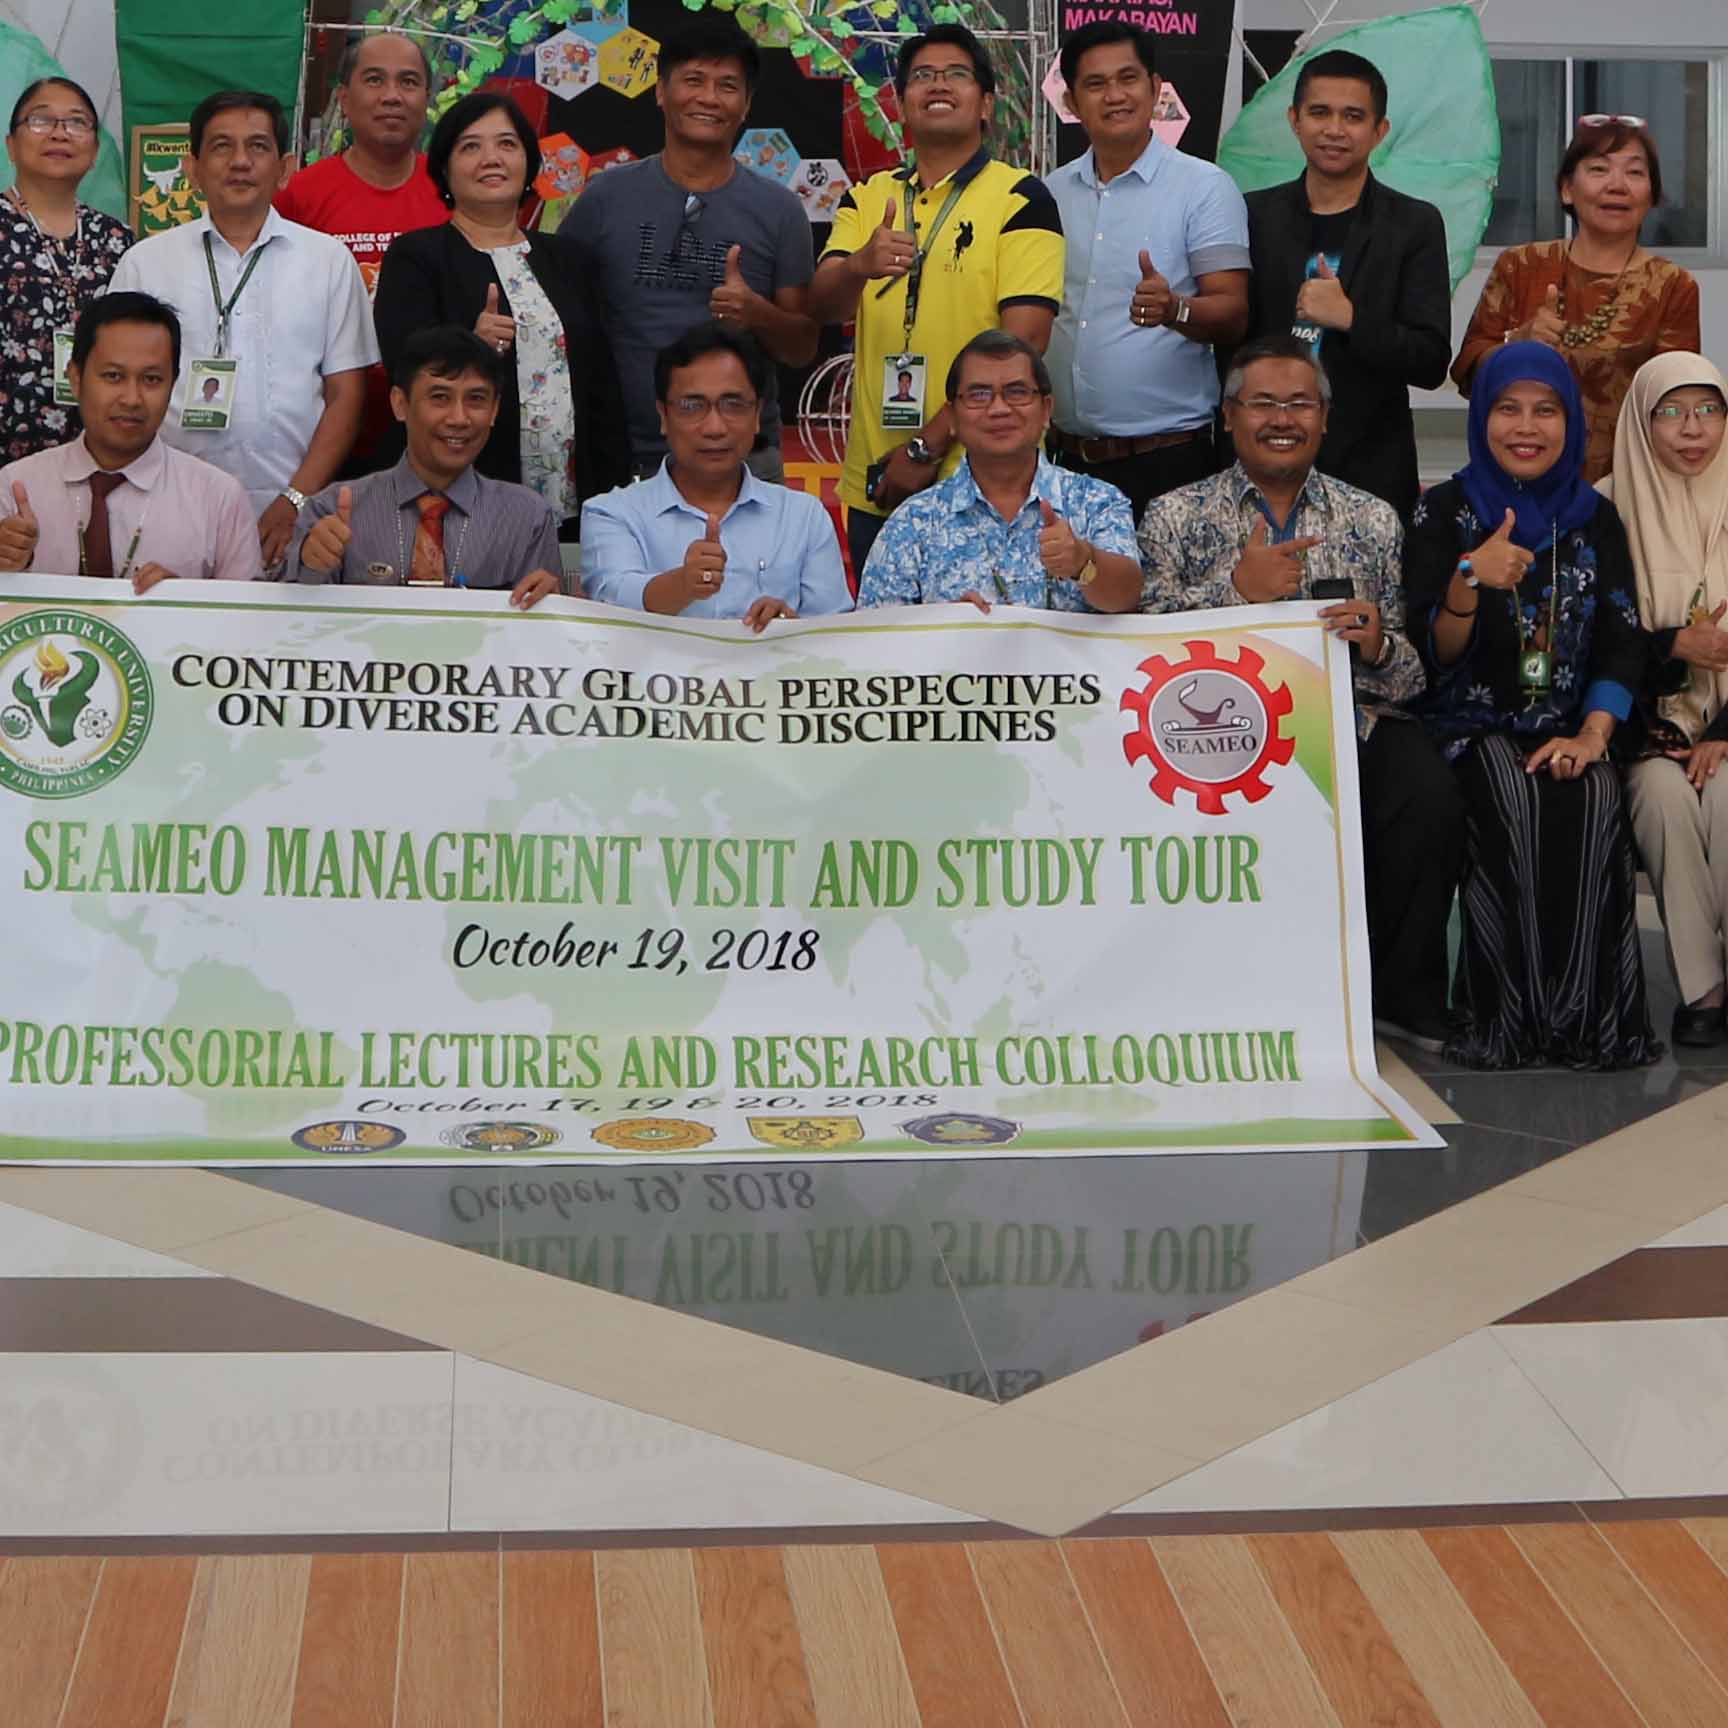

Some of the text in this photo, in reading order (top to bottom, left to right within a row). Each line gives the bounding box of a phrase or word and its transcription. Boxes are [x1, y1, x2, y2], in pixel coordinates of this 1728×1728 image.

[107, 649, 146, 765] UNIVERSITY
[171, 653, 1101, 710] CONTEMPORARY GLOBAL PERSPECTIVES
[218, 693, 1057, 744] ON DIVERSE ACADEMIC DISCIPLINES
[1164, 735, 1257, 754] SEAMEO
[23, 820, 1262, 908] SEAMEO MANAGEMENT VISIT AND STUDY TOUR
[452, 921, 820, 976] October 19, 2018
[359, 1031, 603, 1089] LECTURES
[617, 1035, 718, 1089] AND
[732, 1035, 980, 1089] RESEARCH
[994, 1030, 1302, 1089] COLLOQUIUM
[357, 1093, 939, 1114] October 17, 19 & 20, 2018
